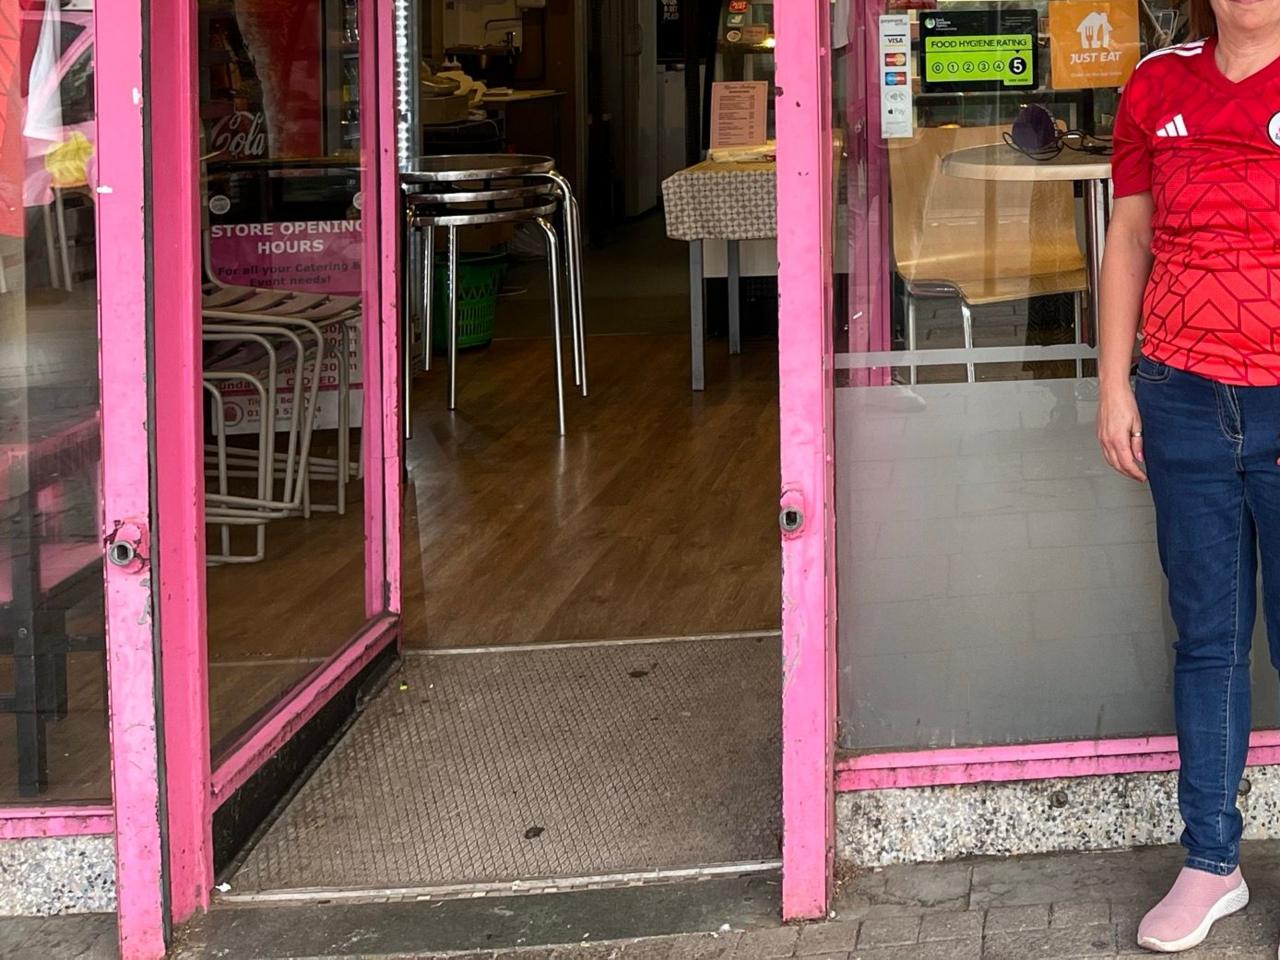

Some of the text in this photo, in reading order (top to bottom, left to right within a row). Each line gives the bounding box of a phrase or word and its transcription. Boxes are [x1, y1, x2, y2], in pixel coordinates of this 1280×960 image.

[931, 39, 1027, 48] FOOD HYGIENE RATING
[1070, 51, 1122, 65] JUST EAT
[1013, 59, 1022, 73] 5
[211, 222, 273, 238] STORE
[258, 239, 324, 255] HOURS
[217, 267, 238, 276] For
[243, 266, 258, 275] all
[262, 266, 291, 276] your
[295, 262, 347, 274] Catering
[250, 276, 331, 287] Event needs!
